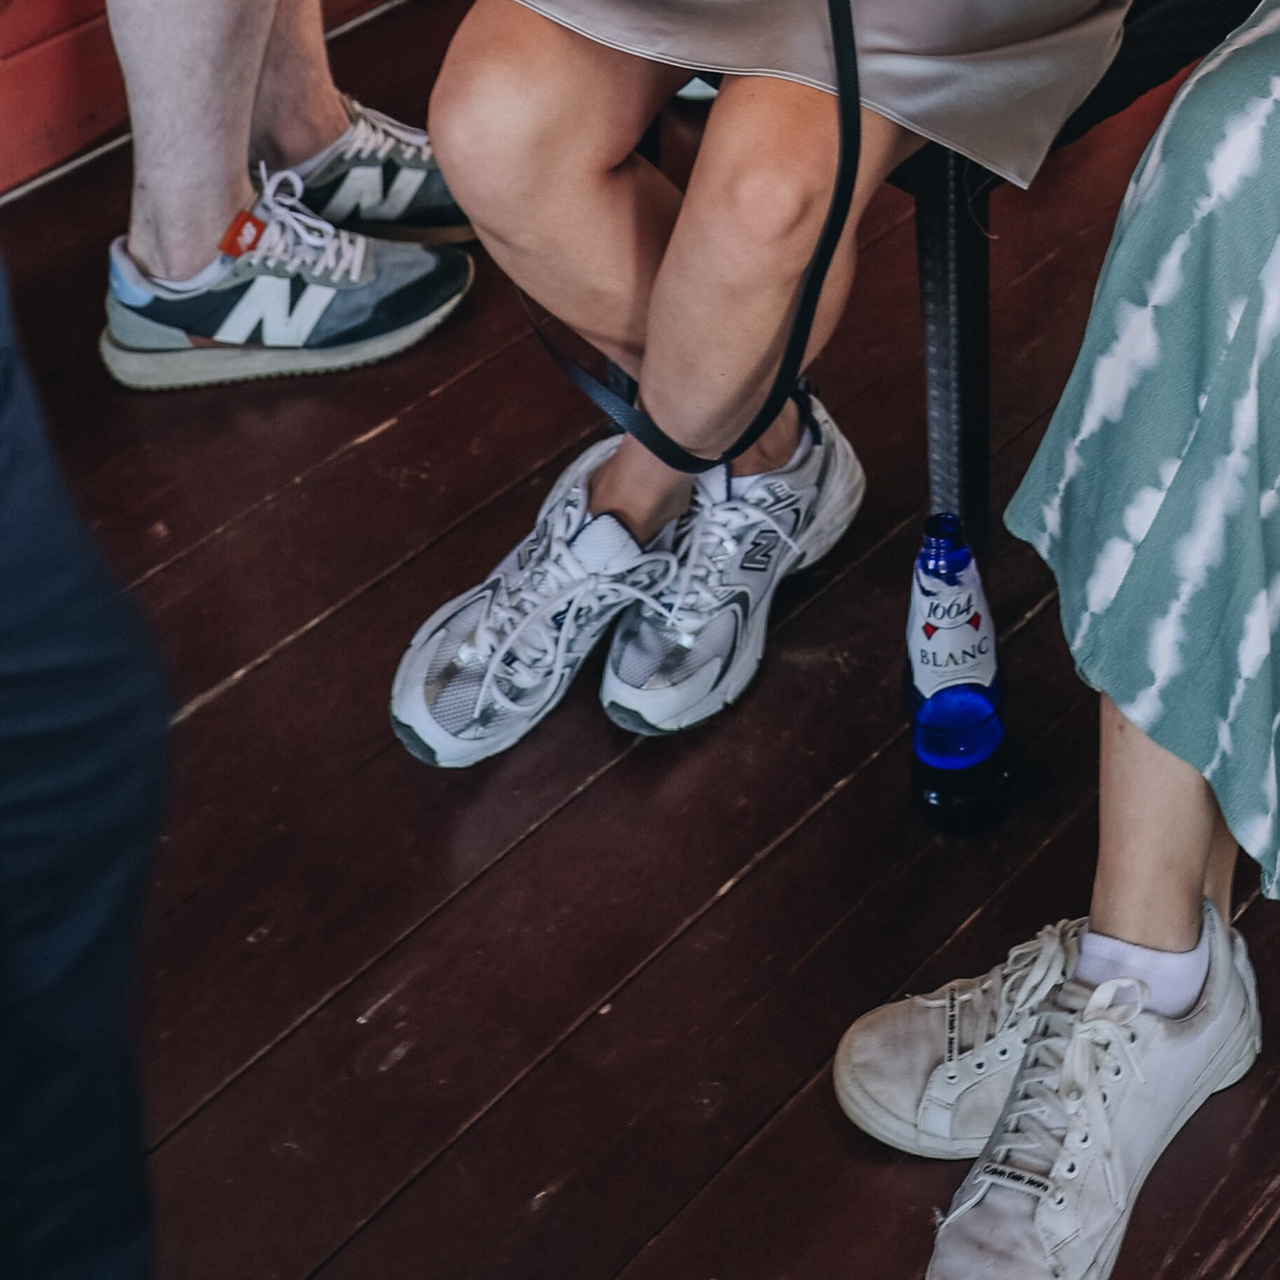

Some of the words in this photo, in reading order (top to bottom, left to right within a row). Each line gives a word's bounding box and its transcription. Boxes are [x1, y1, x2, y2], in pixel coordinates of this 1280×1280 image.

[321, 166, 427, 222] N
[213, 274, 337, 347] N
[927, 592, 974, 620] 1664
[920, 635, 990, 668] BLANC
